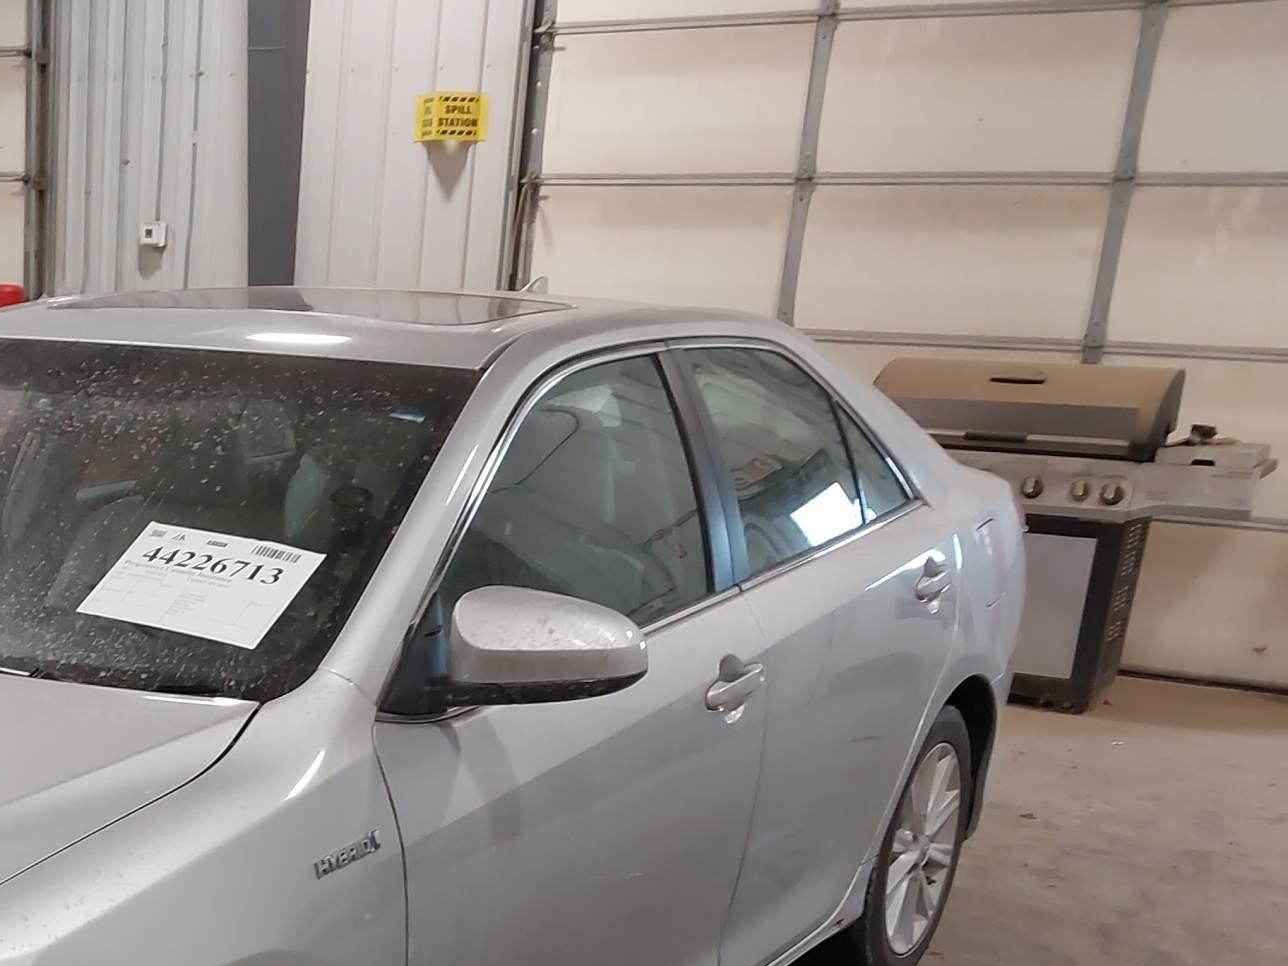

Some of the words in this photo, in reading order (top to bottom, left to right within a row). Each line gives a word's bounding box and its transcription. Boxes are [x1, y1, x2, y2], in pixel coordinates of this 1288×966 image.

[445, 105, 472, 114] SPILL
[438, 118, 478, 127] STATION
[142, 546, 284, 585] 44226713
[313, 829, 381, 880] HYBRID
